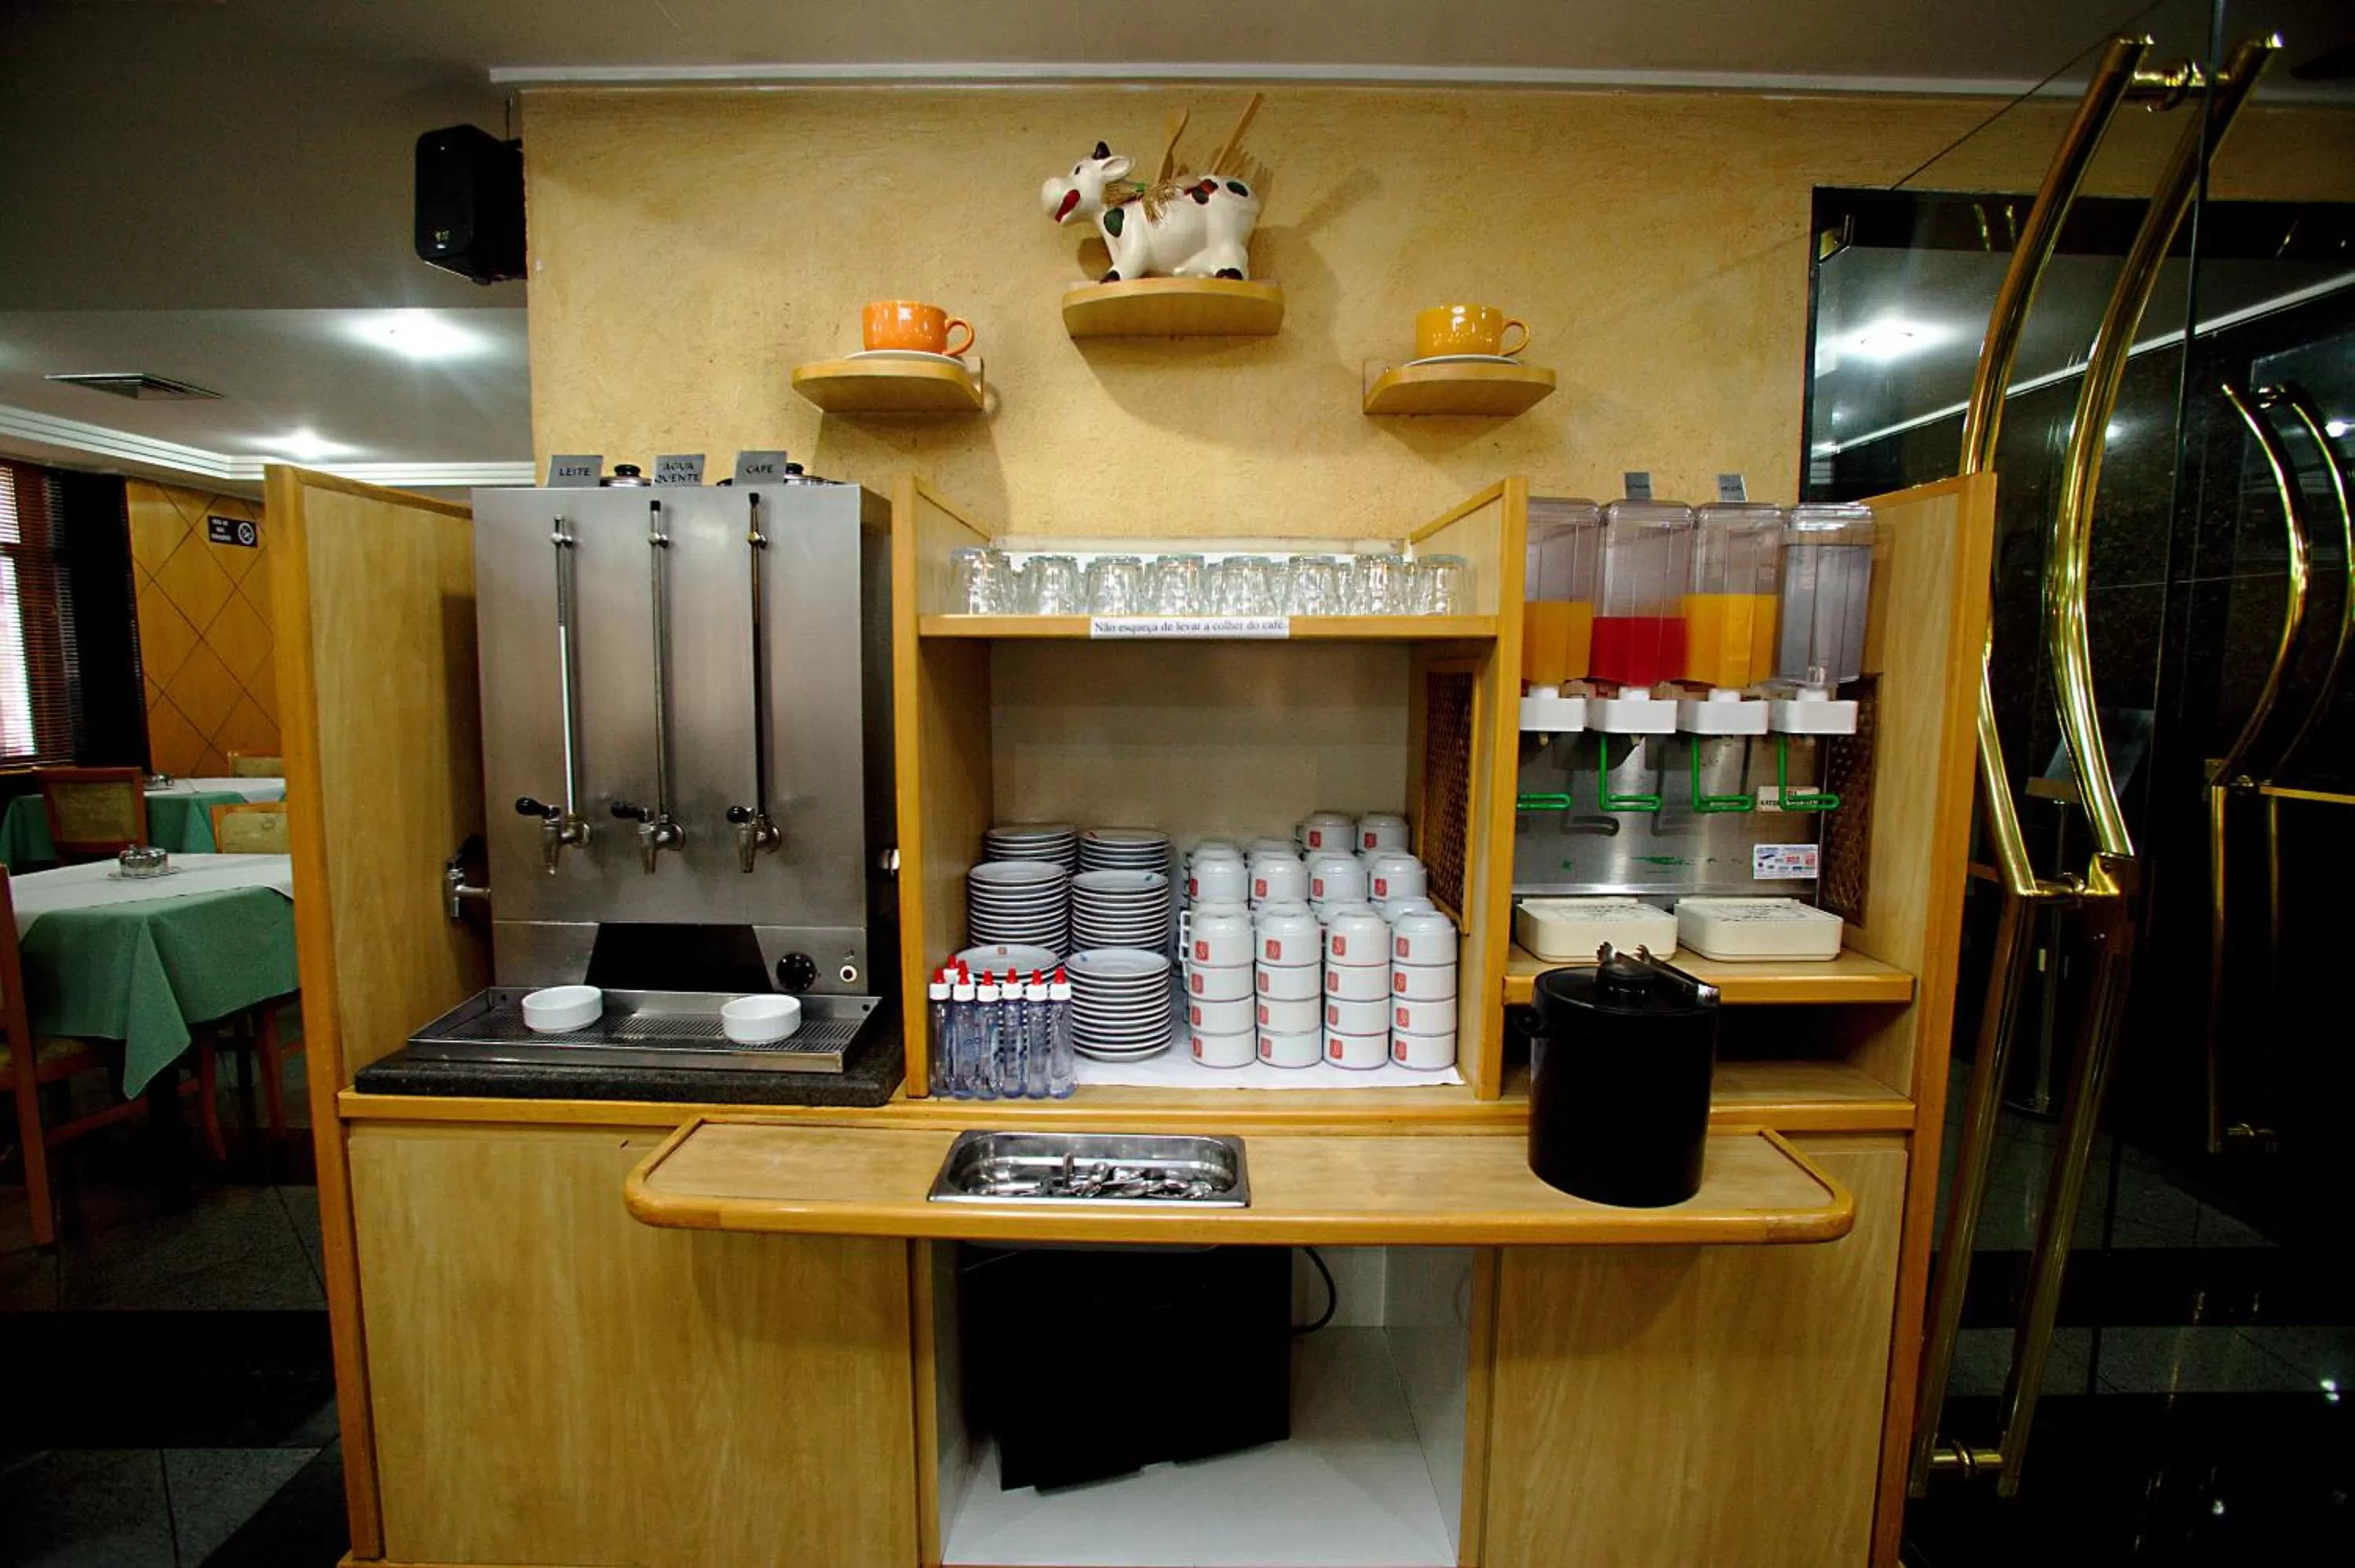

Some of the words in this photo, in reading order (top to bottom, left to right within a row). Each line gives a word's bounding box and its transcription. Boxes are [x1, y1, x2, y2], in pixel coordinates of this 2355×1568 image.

[558, 466, 591, 476] LEITE
[654, 472, 699, 484] QUENTE
[1094, 622, 1115, 632] Não
[1117, 624, 1159, 635] esqueça
[1160, 621, 1174, 632] de
[1176, 621, 1201, 633] levar
[1246, 619, 1260, 630] do
